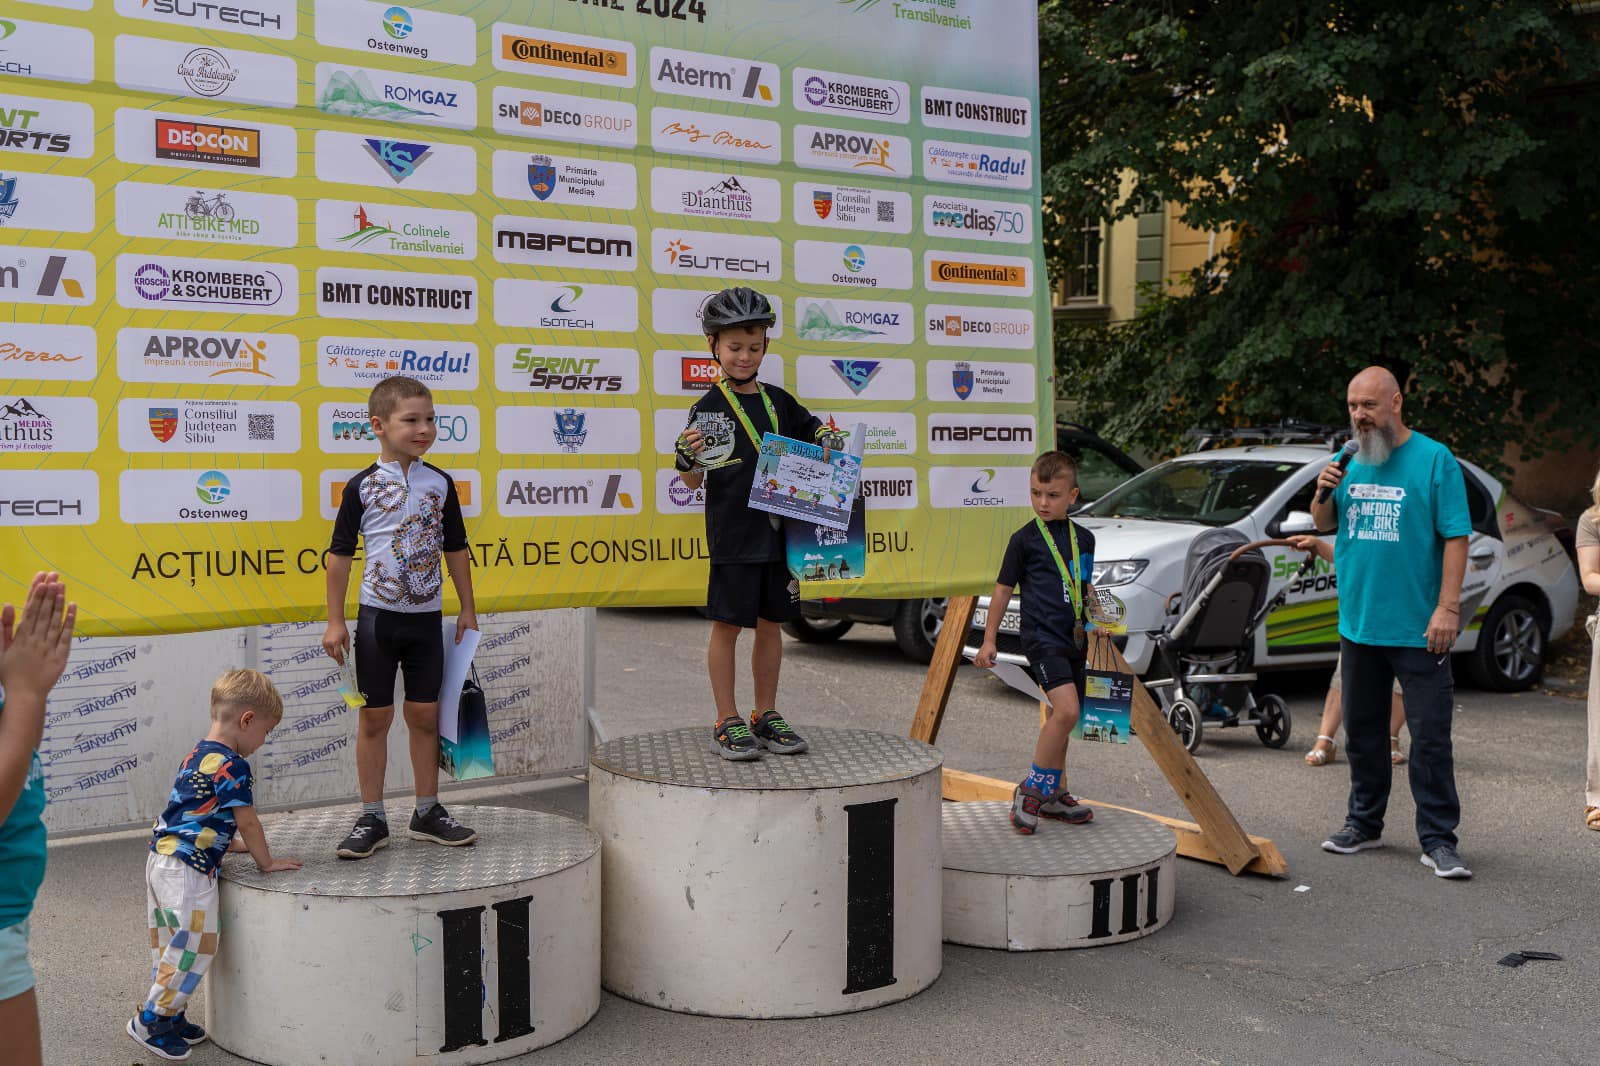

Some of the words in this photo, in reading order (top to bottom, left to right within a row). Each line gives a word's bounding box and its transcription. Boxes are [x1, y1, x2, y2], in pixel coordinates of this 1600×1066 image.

[153, 0, 280, 30] SUTECH
[637, 0, 706, 23] 2024
[892, 3, 972, 30] Transilvaniei
[367, 38, 428, 59] Ostenweg
[511, 40, 604, 68] Continental
[657, 58, 732, 91] Aterm
[384, 84, 458, 108] ROMGAZ
[828, 82, 889, 100] KROMBERG
[828, 94, 836, 104] &
[837, 95, 894, 111] SCHUBERT
[498, 104, 519, 119] SN
[584, 115, 633, 131] GROUP
[924, 98, 952, 117] BMT
[954, 102, 1027, 126] CONSTRUCT
[168, 129, 249, 152] DEOCON
[810, 131, 874, 155] APROV
[380, 139, 415, 178] KS
[979, 154, 1026, 176] Radu!
[681, 190, 752, 213] Dianthus
[157, 213, 190, 231] ATTI
[193, 216, 225, 234] BIKE
[229, 219, 260, 236] MED
[403, 223, 451, 239] Colinele
[389, 237, 465, 256] Transilvaniei
[678, 254, 770, 274] SUTECH
[938, 262, 1009, 282] Continental
[134, 277, 171, 288] KROSCHU
[172, 269, 266, 288] KROMBERG
[172, 284, 183, 297] &
[186, 284, 273, 301] SCHUBERT
[322, 282, 363, 304] BMT
[367, 285, 473, 310] CONSTRUCT
[540, 317, 595, 329] ISOTECH
[845, 311, 900, 327] ROMGAZ
[929, 319, 945, 331] SN
[144, 335, 242, 360] APROV
[389, 348, 402, 358] cu
[401, 349, 471, 373] Radu!
[512, 348, 601, 375] SPRINT
[530, 368, 623, 392] SPORTS
[843, 360, 868, 391] KS
[184, 408, 238, 421] Consiliul
[3, 422, 53, 441] thus
[184, 432, 215, 445] Sibiu
[435, 415, 468, 443] 50
[864, 427, 897, 439] olinele
[505, 480, 590, 506] Aterm
[859, 479, 913, 497] STRUCT
[963, 497, 1004, 506] ISOTECH
[179, 507, 249, 521] Ostenweg
[1373, 516, 1399, 531] BIKE
[867, 531, 914, 554] IBIU.
[1357, 530, 1400, 542] MARATHON
[523, 541, 562, 567] DE
[571, 537, 710, 566] CONSILIUL
[131, 549, 286, 588] ACȚIUNE
[1289, 576, 1337, 594] SPOR
[482, 624, 531, 651] ALUPANEL
[74, 647, 137, 681] ALUPANEL
[293, 645, 326, 665] PANEL
[483, 656, 531, 683] ALUPANEL
[293, 671, 342, 699] LUPANEL
[75, 684, 138, 717] ALUPANEL
[487, 688, 531, 714] ALUPANE
[293, 703, 348, 733] ALUPANEL
[75, 720, 138, 754] ALUPANEL
[293, 736, 348, 768] ALUPANEL
[76, 757, 138, 791] ALUPANEL
[1088, 867, 1160, 939] III
[437, 894, 534, 1054] II
